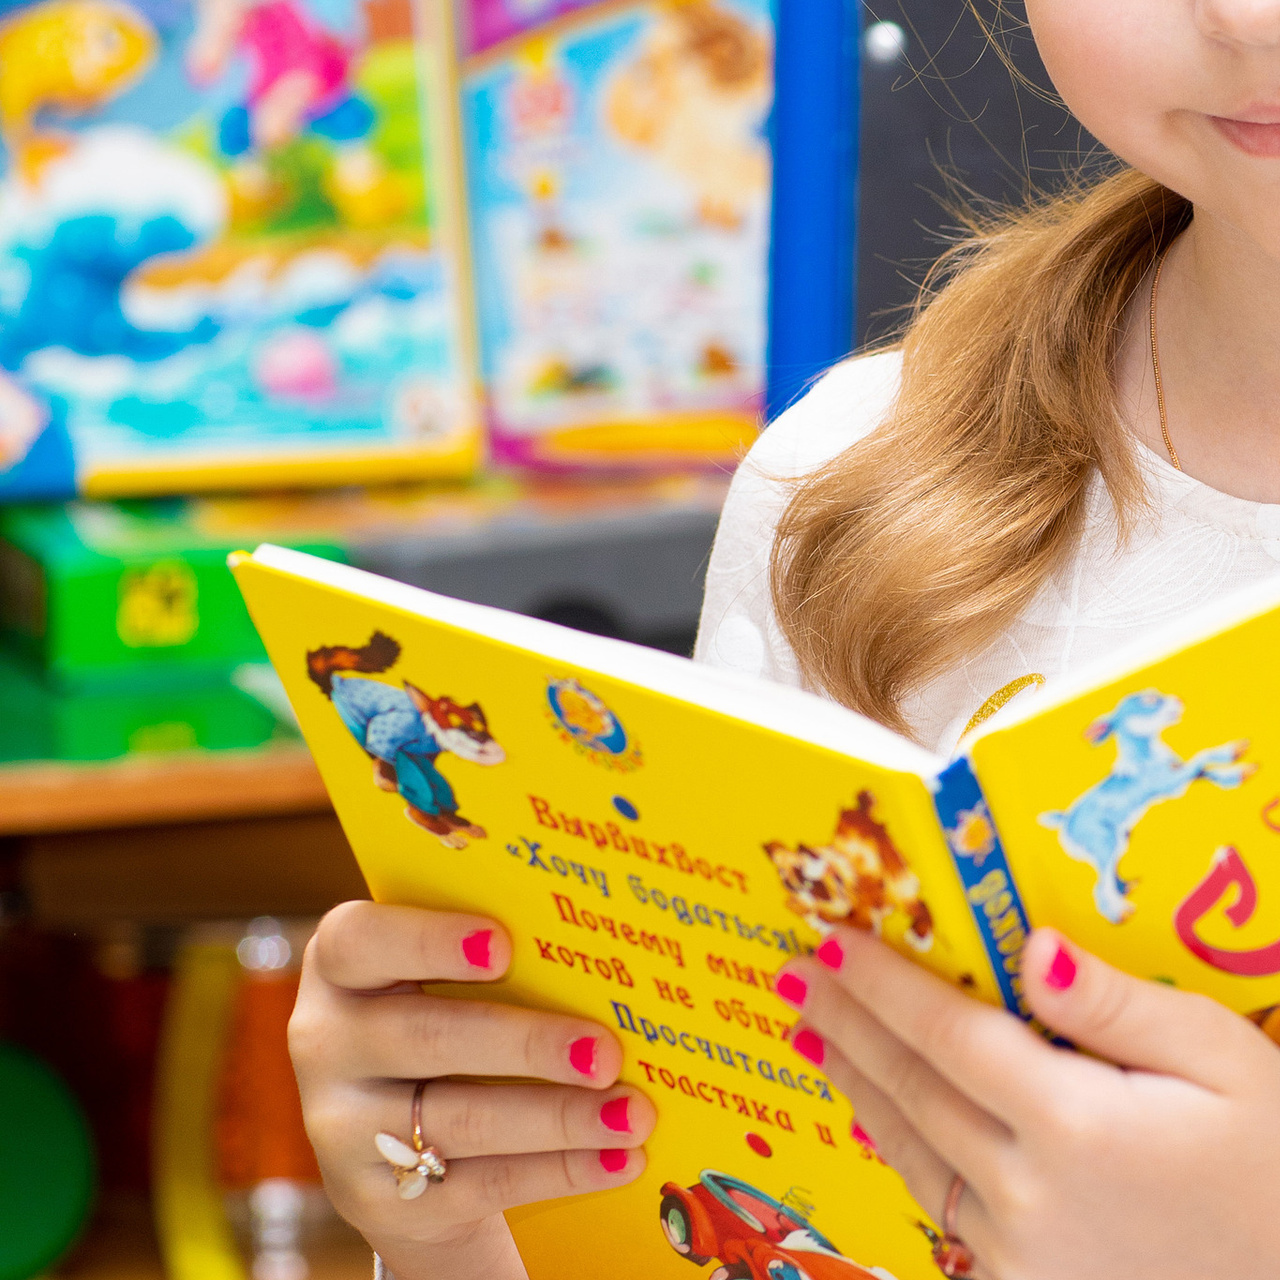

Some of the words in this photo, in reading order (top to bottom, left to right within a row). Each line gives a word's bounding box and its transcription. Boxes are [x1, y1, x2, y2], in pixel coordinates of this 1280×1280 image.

[526, 792, 749, 894] Вырвихвост
[506, 835, 610, 899] «Хочу
[627, 873, 814, 958] бодаться!
[551, 891, 685, 969] Почему
[534, 936, 634, 989] котов
[653, 976, 694, 1009] не
[610, 999, 834, 1103] Просчитался
[637, 1058, 795, 1134] толстяка
[814, 1121, 837, 1149] и
